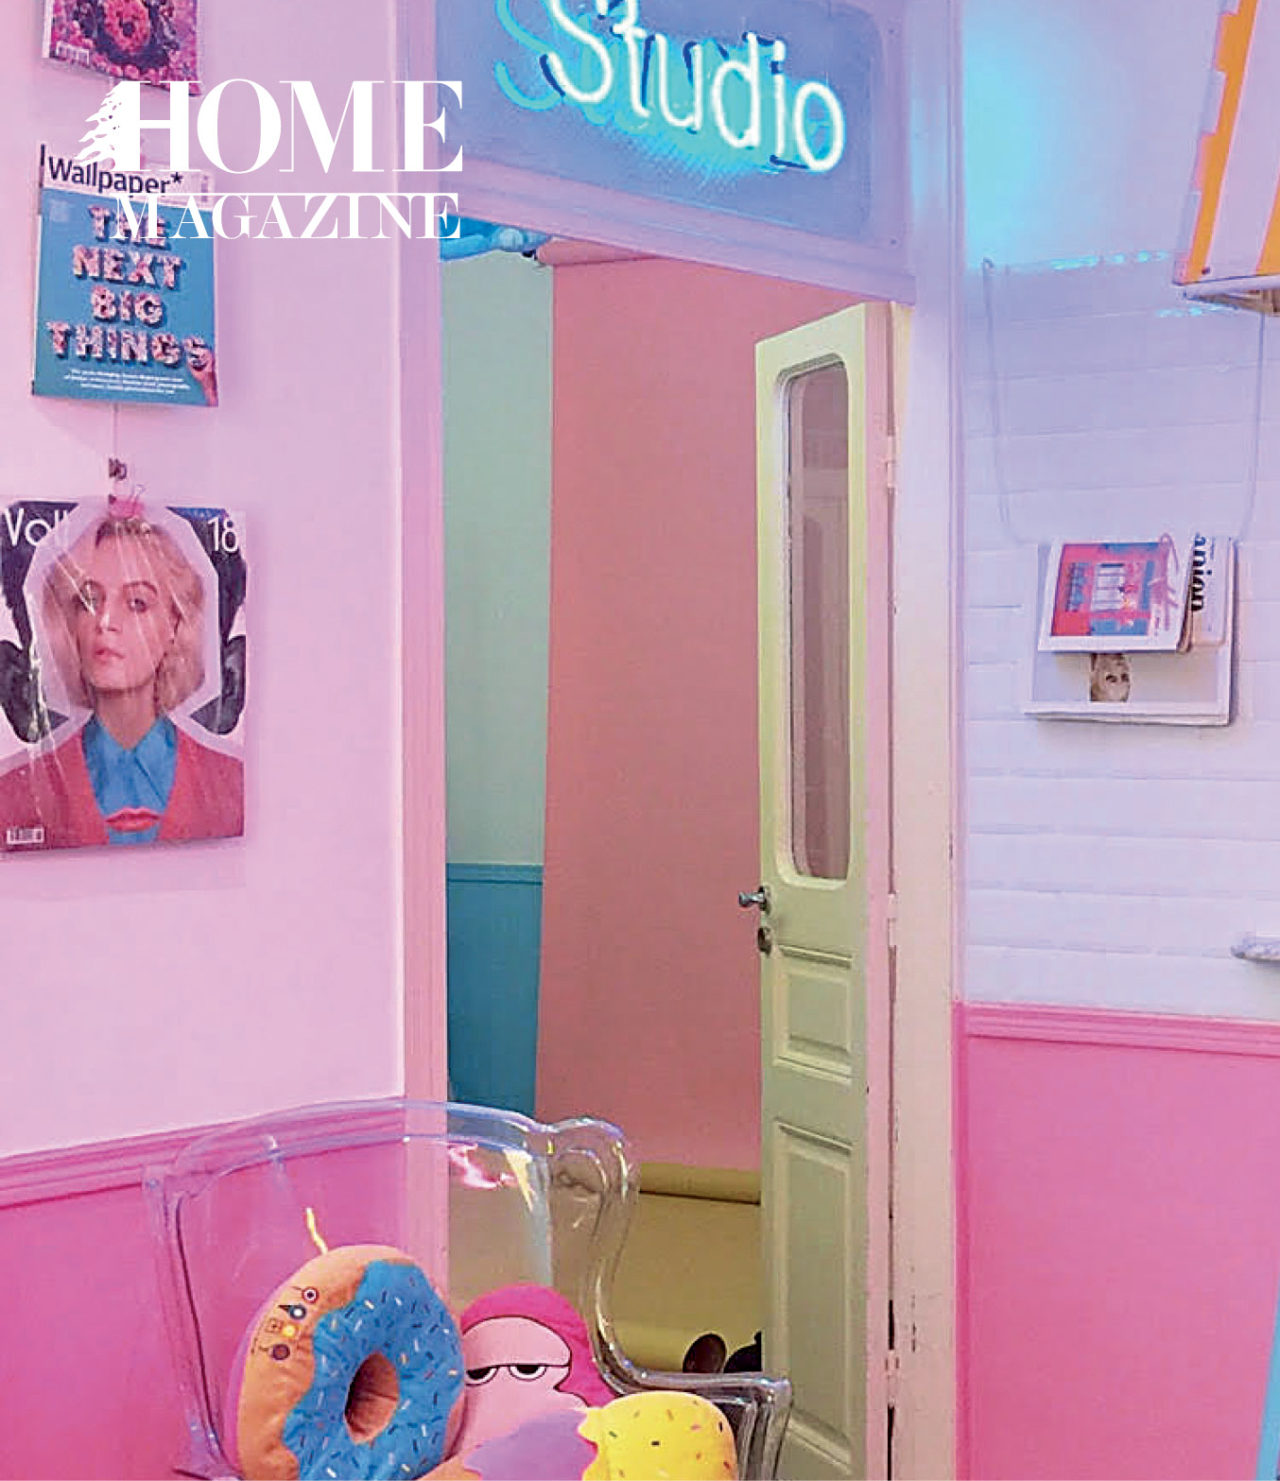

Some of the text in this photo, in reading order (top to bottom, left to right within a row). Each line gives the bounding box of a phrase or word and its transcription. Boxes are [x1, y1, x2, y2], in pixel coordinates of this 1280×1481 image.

[544, 0, 844, 171] Studio
[72, 244, 184, 289] NEXT
[90, 285, 164, 325] BIG
[46, 319, 215, 371] THINGS
[207, 515, 239, 554] 18
